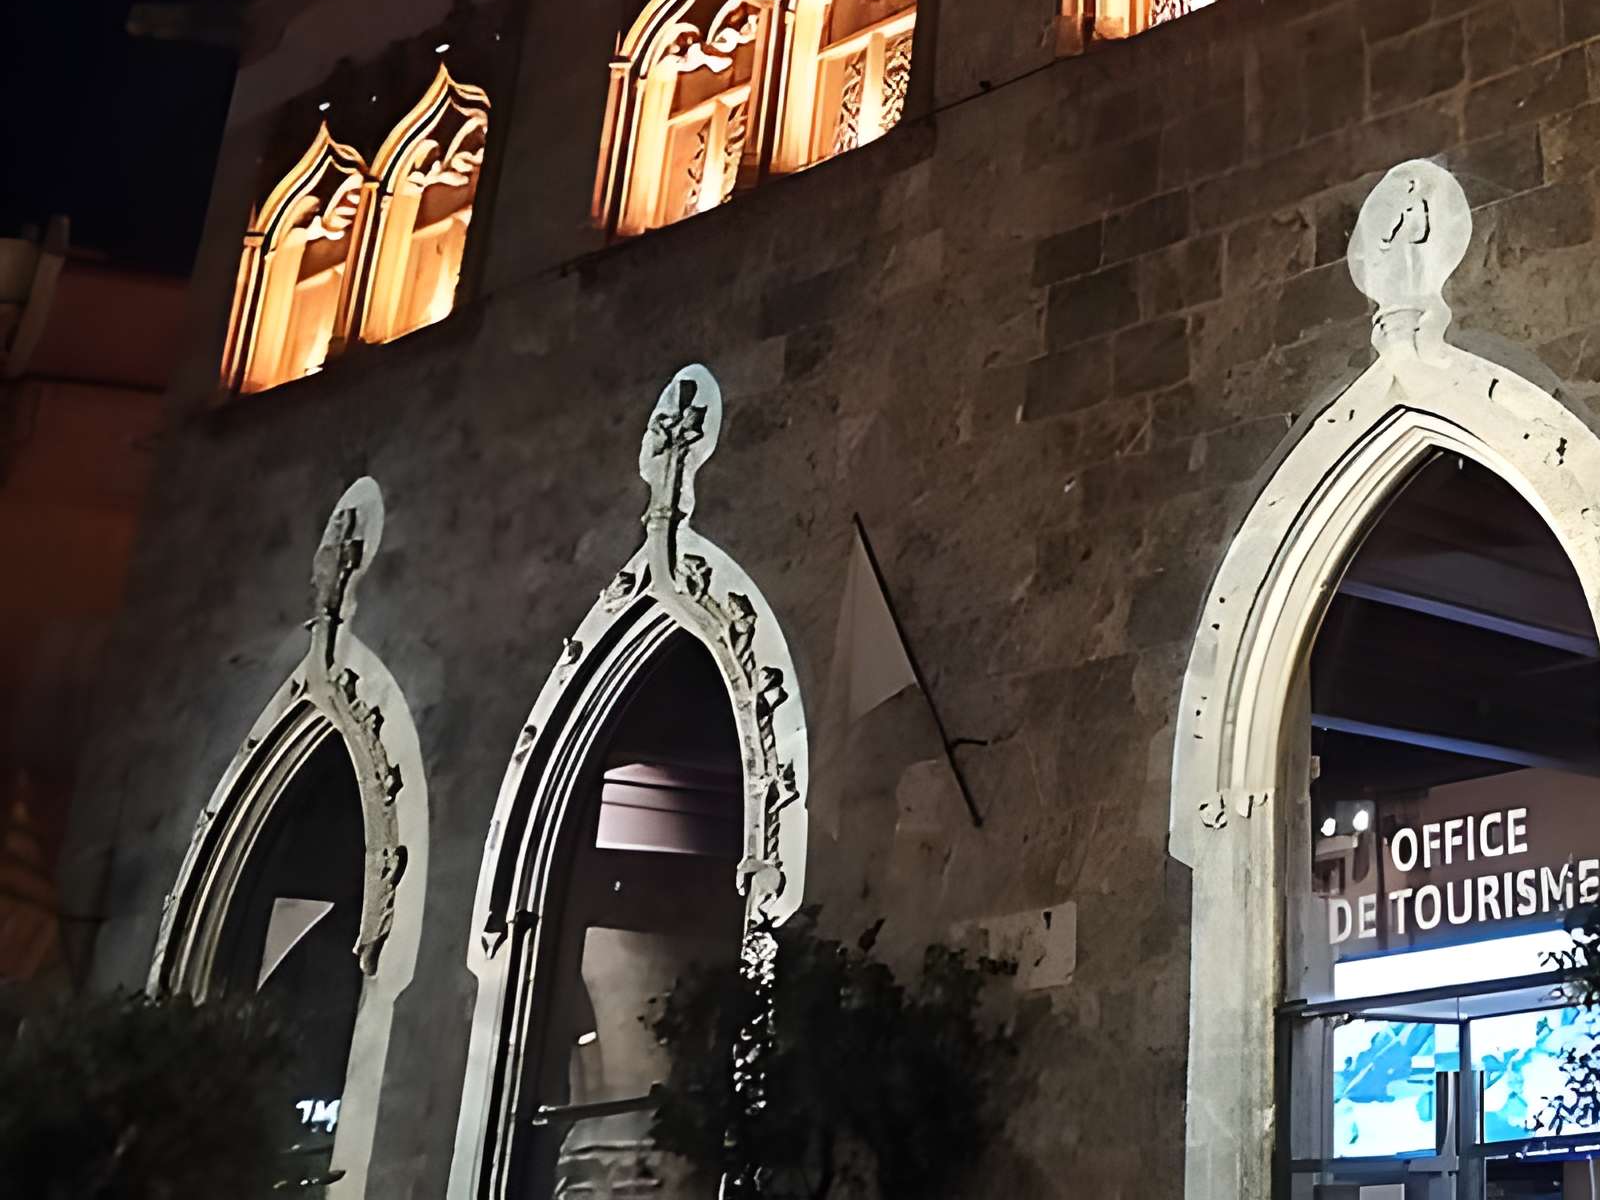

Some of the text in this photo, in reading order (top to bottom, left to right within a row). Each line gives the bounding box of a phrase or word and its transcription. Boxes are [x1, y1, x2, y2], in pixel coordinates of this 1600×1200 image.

[1391, 808, 1528, 872] OFFICE
[1328, 859, 1600, 944] DE TOURISME
